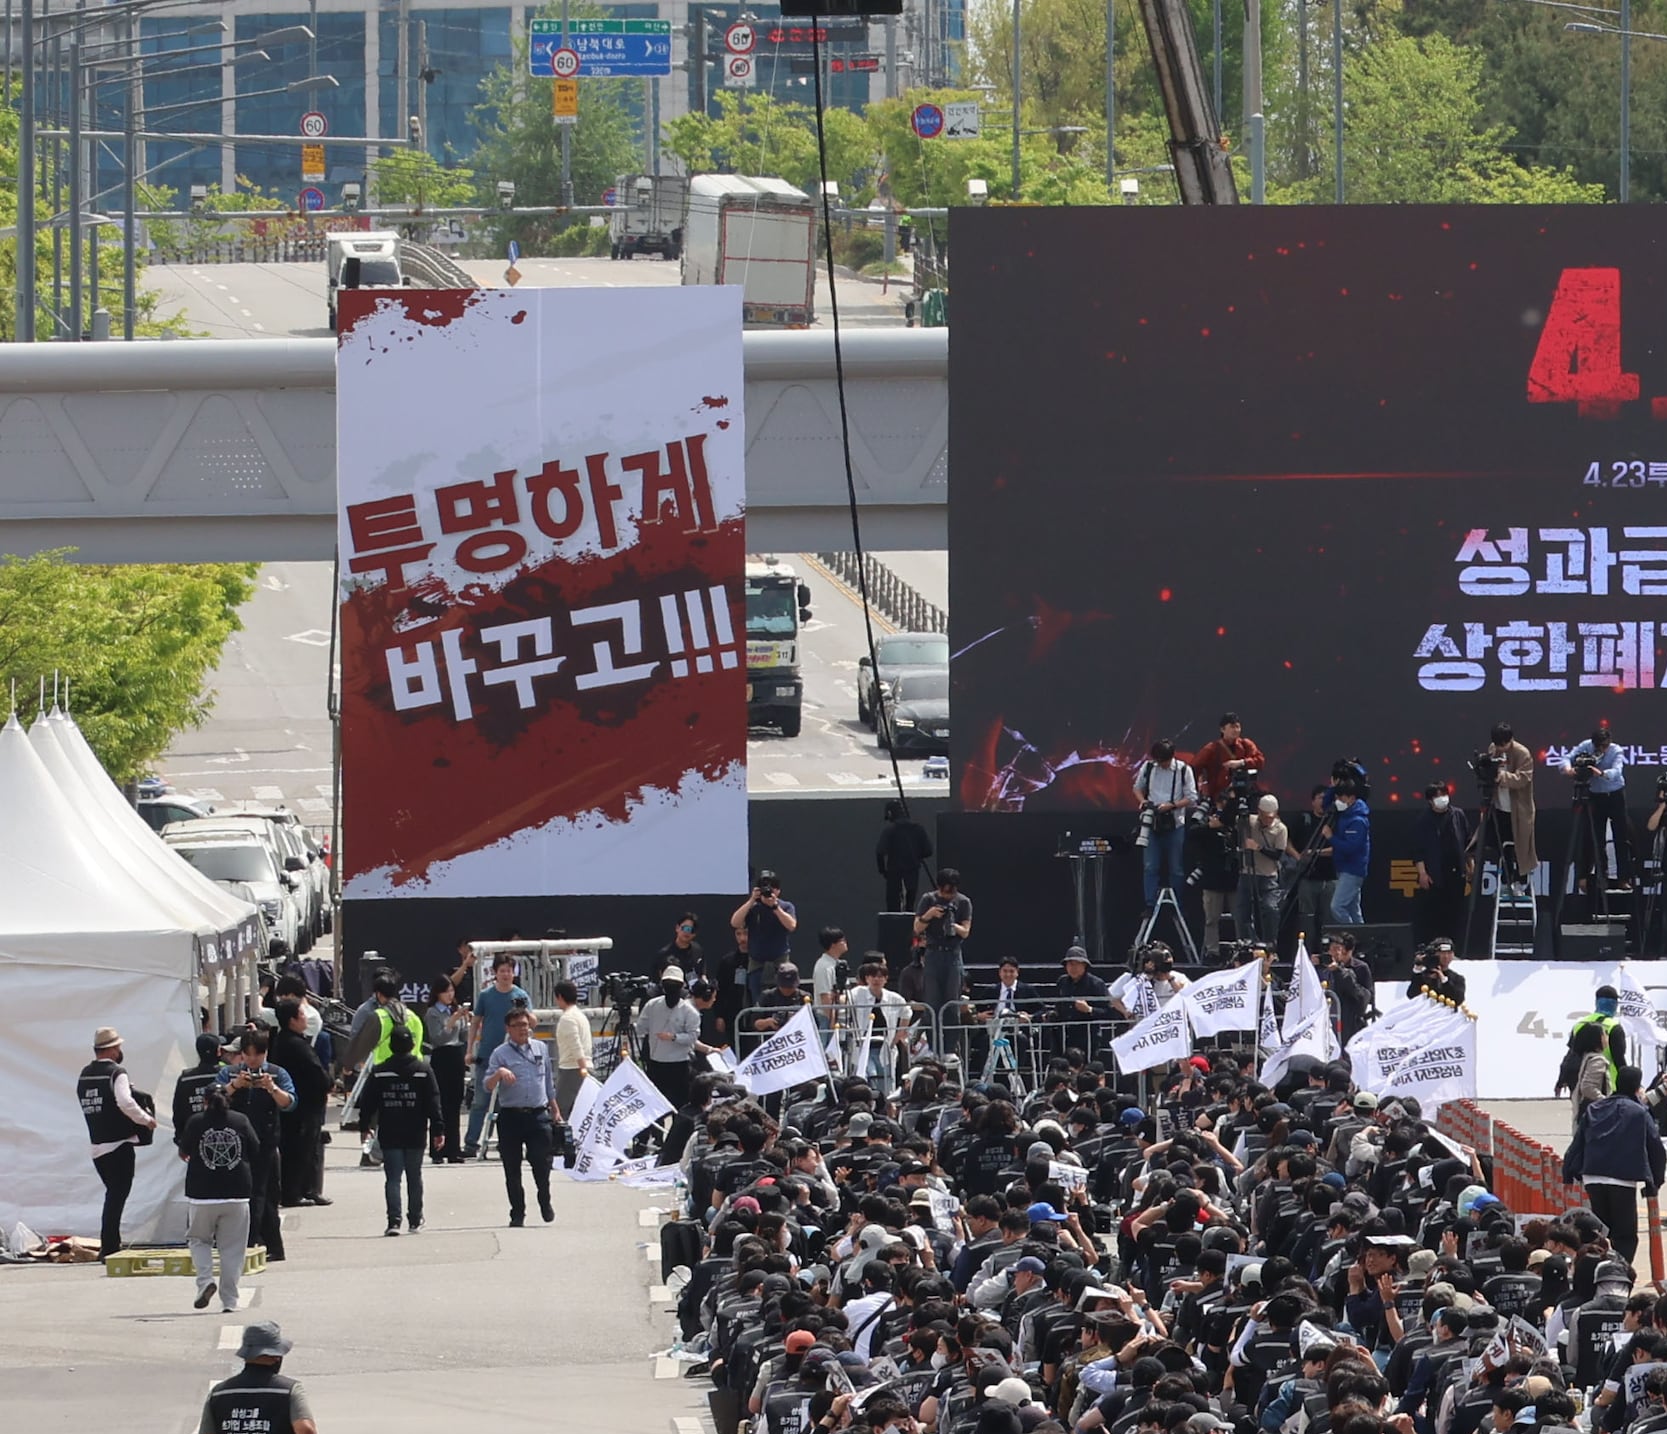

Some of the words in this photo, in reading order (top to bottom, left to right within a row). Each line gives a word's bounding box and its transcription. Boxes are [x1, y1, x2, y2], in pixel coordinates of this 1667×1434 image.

[557, 57, 573, 69] 60
[306, 120, 322, 132] 60
[346, 434, 719, 592] 투명하게
[385, 585, 738, 721] 바꾸고!!!
[231, 1407, 259, 1419] 삼성그룹
[243, 1420, 270, 1432] 노동조합
